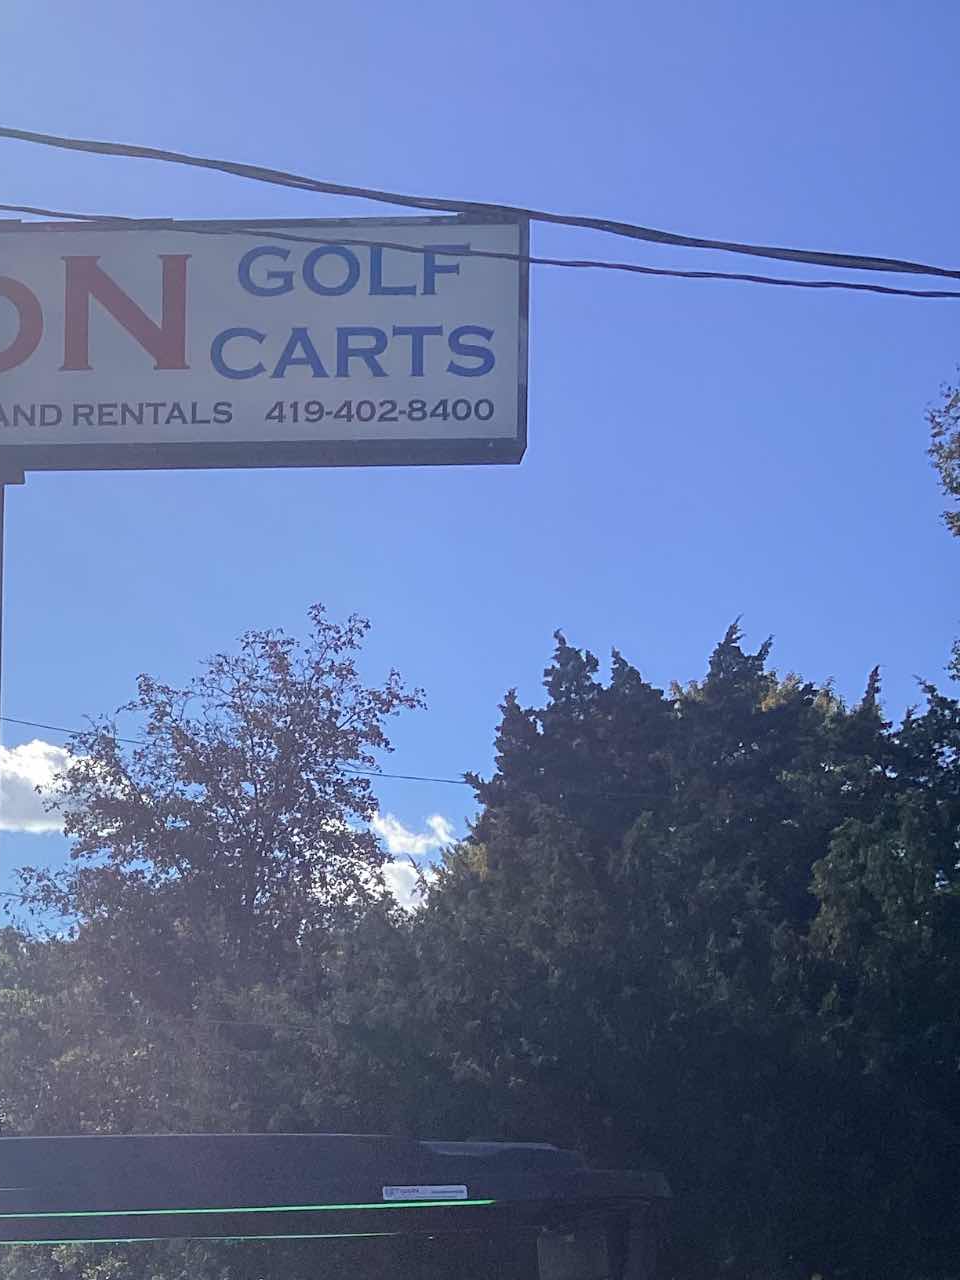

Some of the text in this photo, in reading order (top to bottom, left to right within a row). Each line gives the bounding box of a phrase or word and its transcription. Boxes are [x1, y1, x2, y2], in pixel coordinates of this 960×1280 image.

[238, 243, 471, 297] GOLF
[210, 325, 496, 380] CARTS
[72, 400, 233, 426] RENTALS
[265, 398, 495, 424] 419-402-8400
